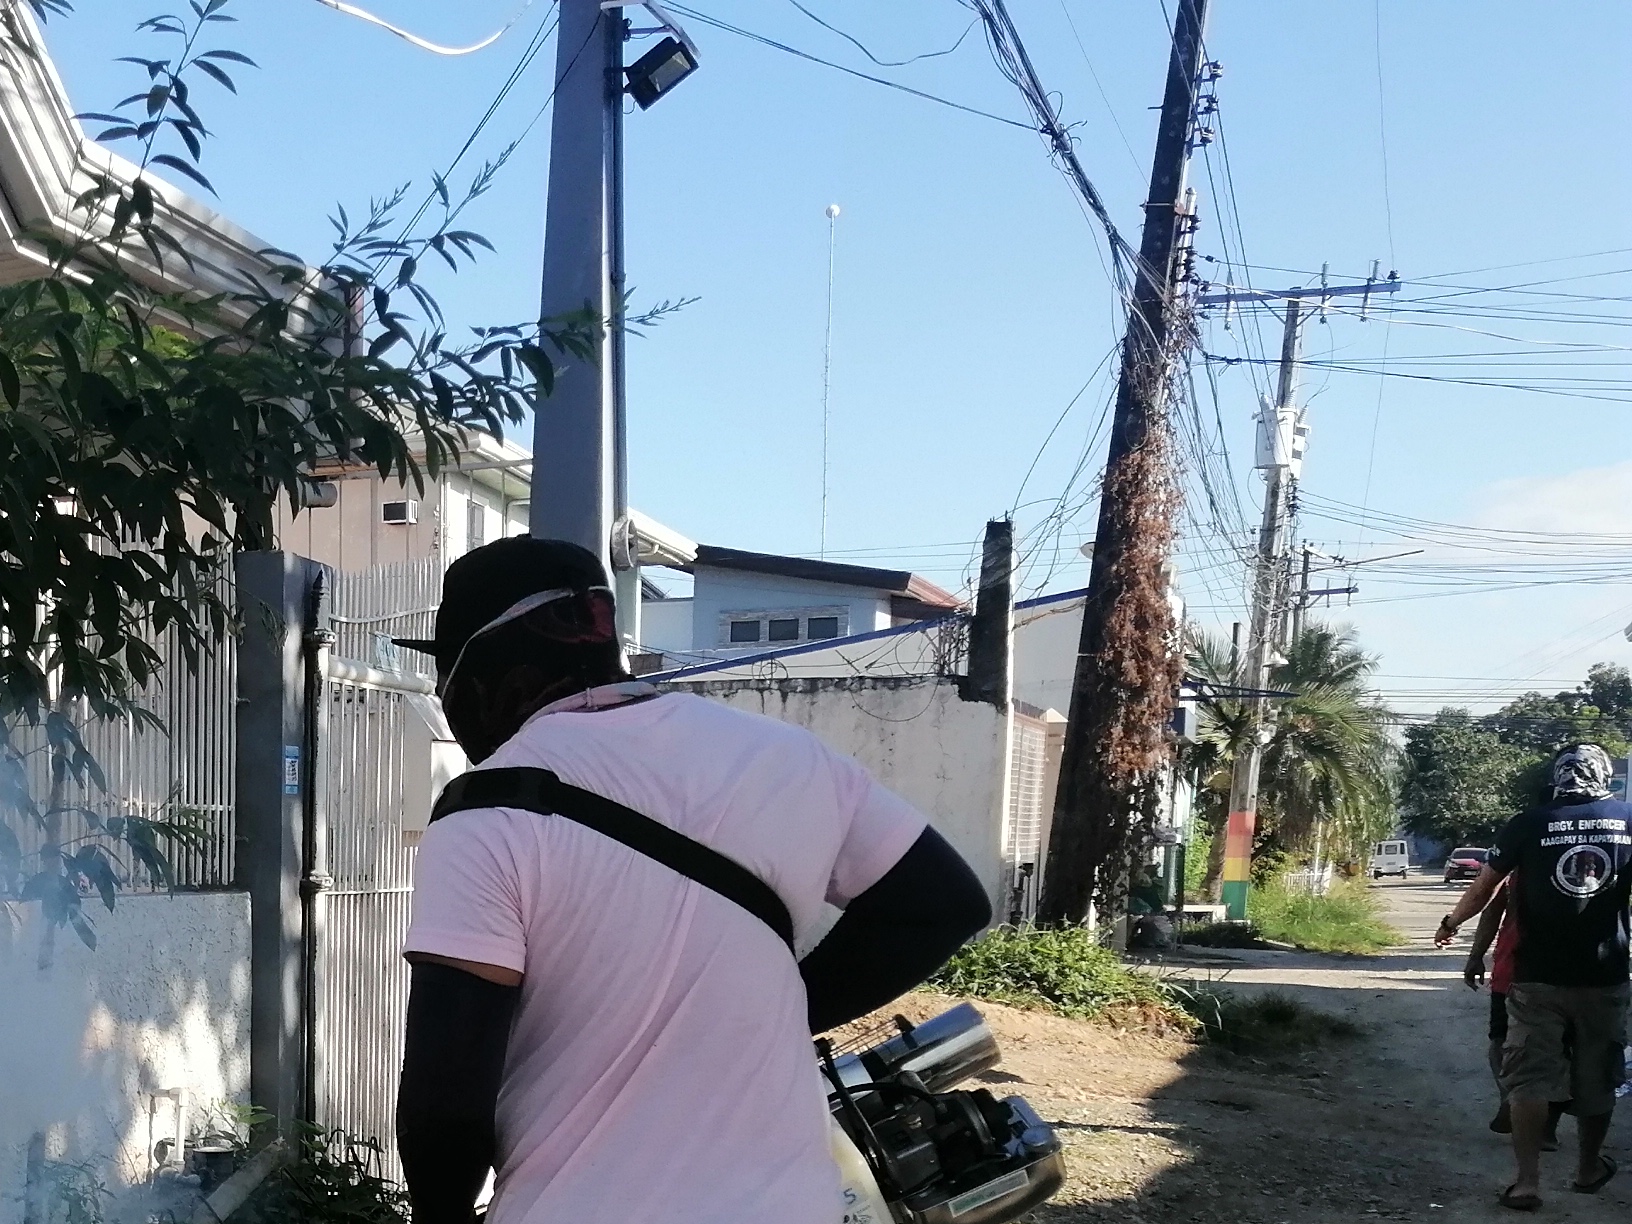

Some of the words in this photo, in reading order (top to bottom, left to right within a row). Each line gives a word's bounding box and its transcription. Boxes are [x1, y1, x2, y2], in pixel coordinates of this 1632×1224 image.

[1548, 820, 1574, 832] BRGY.
[1578, 818, 1626, 831] ENFORCER
[1540, 835, 1576, 846] KAAGAPAY
[1578, 834, 1587, 843] SA
